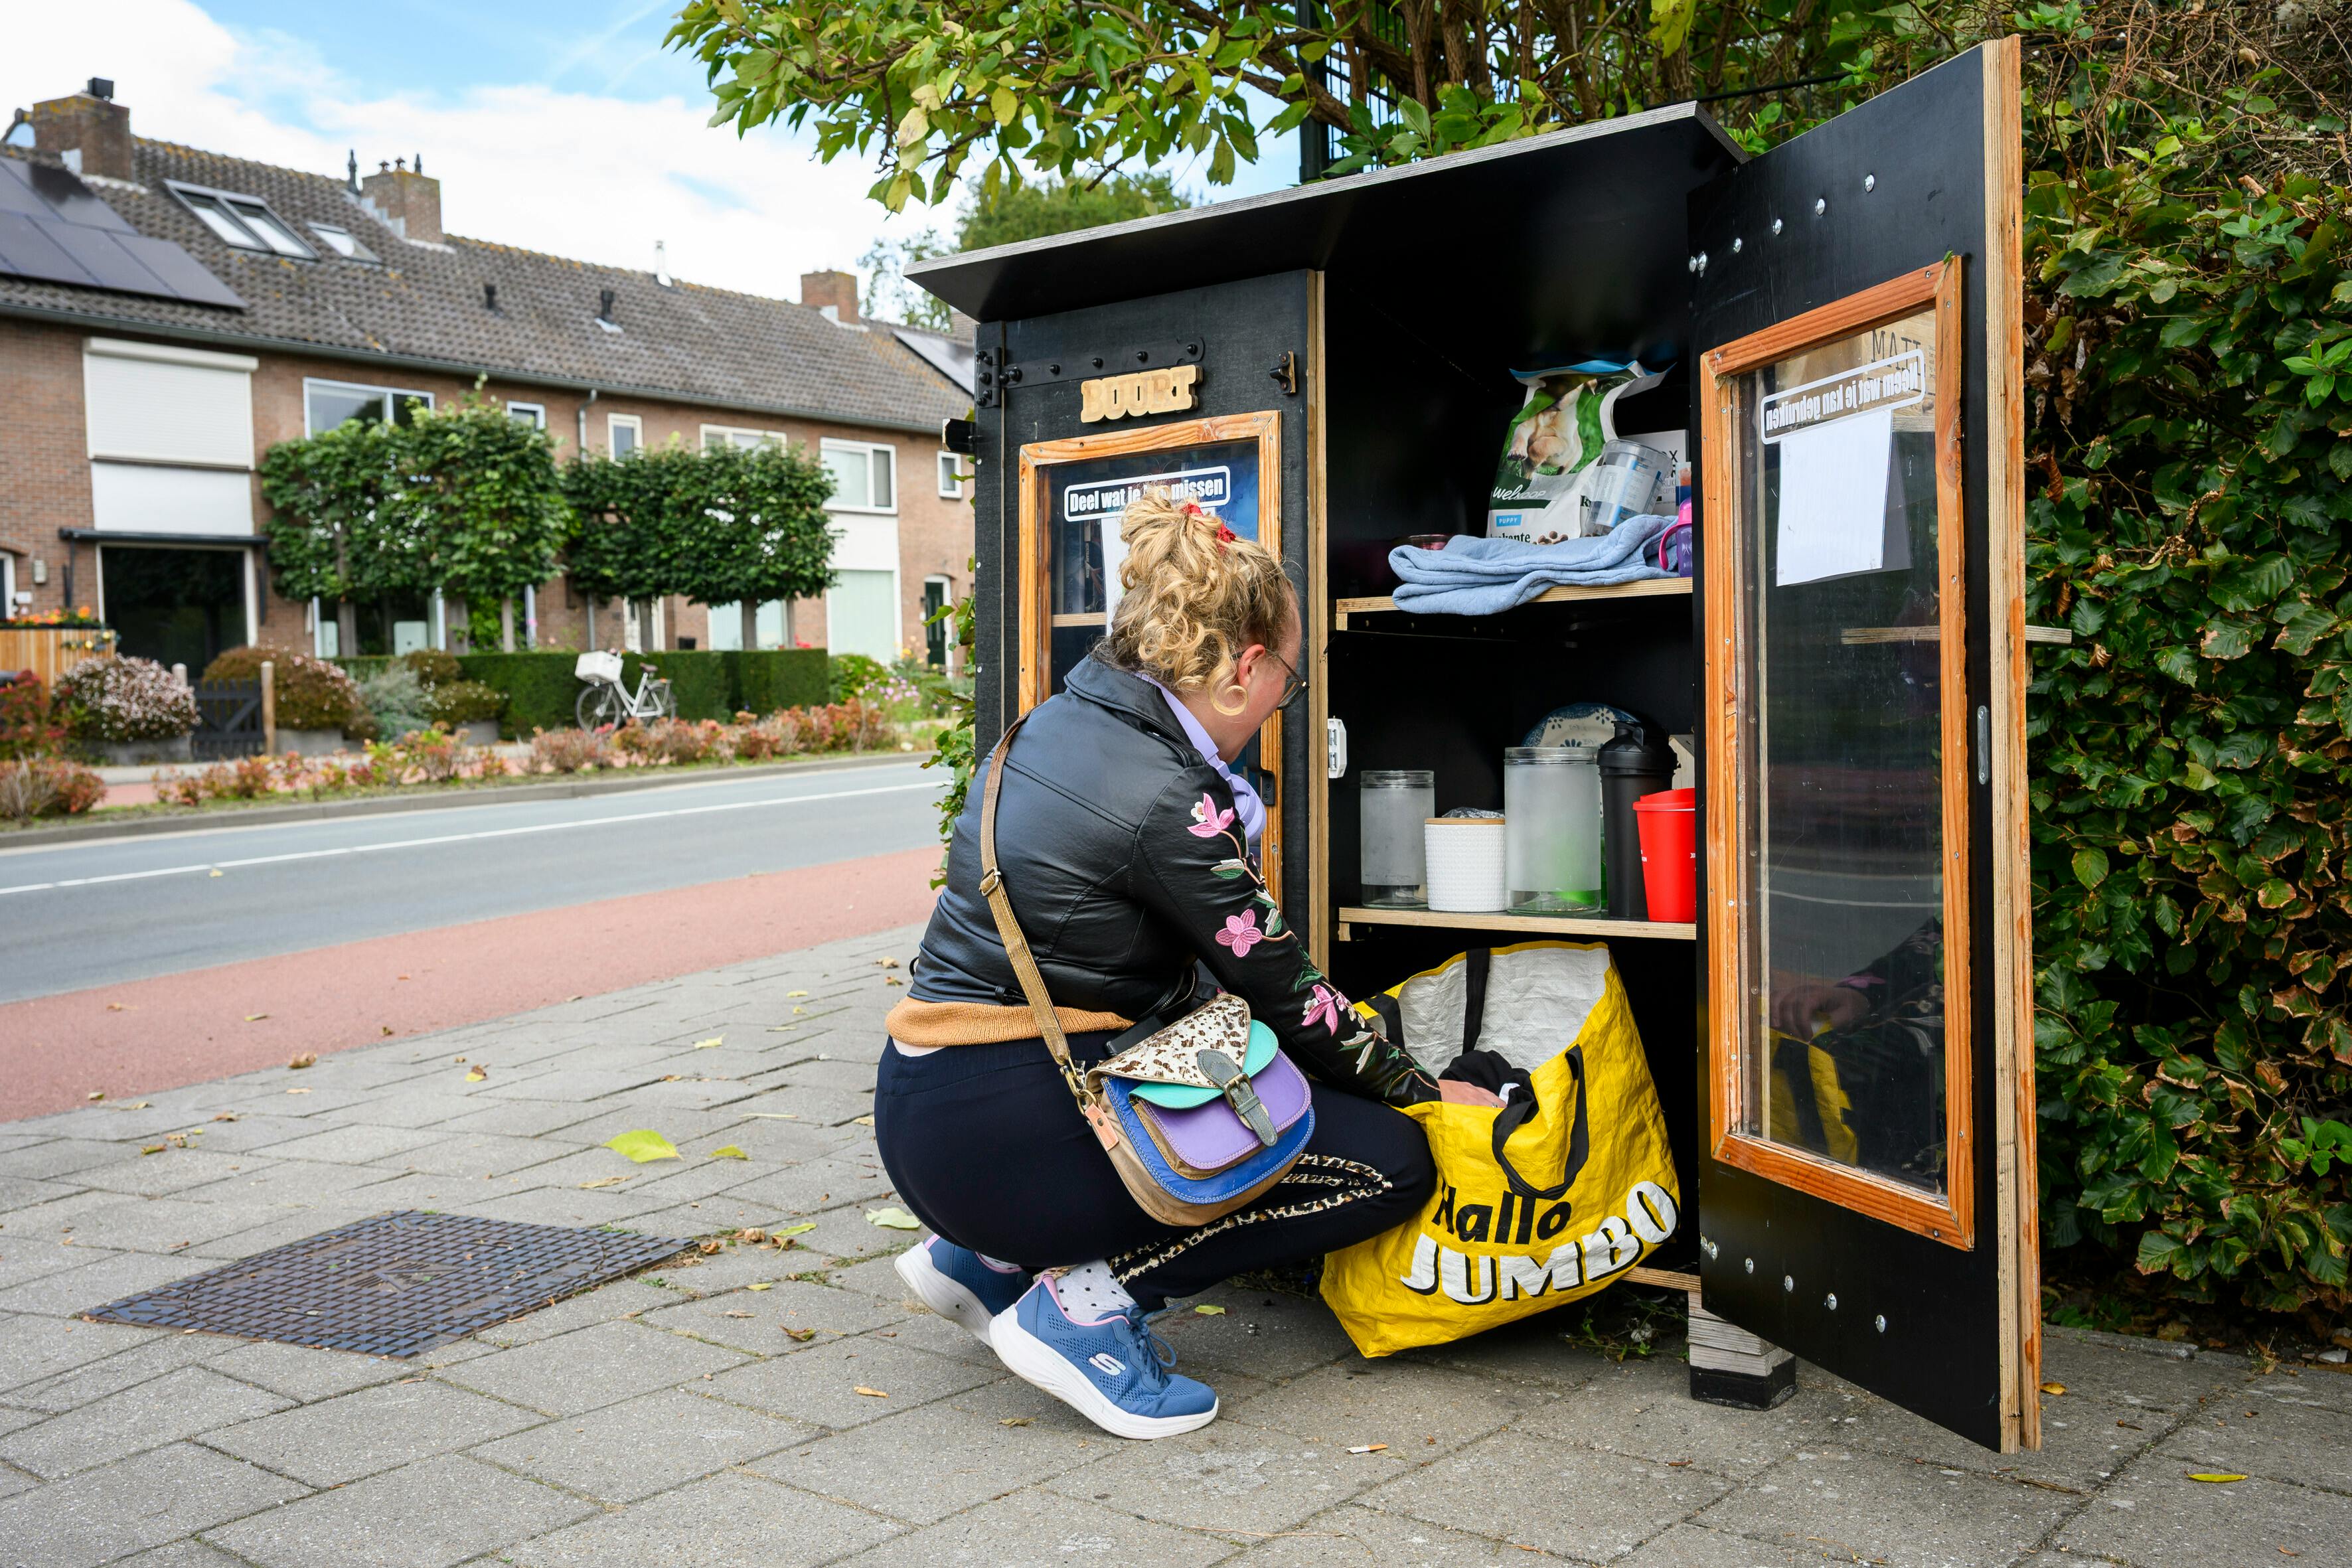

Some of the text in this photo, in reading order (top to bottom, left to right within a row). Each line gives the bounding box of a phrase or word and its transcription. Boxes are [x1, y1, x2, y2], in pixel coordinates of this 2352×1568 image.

[1081, 364, 1197, 423] BUURT
[1069, 490, 1099, 512] Deel
[1101, 489, 1126, 509] wat
[1171, 478, 1223, 501] missen
[1400, 1180, 1681, 1306] JUMBO
